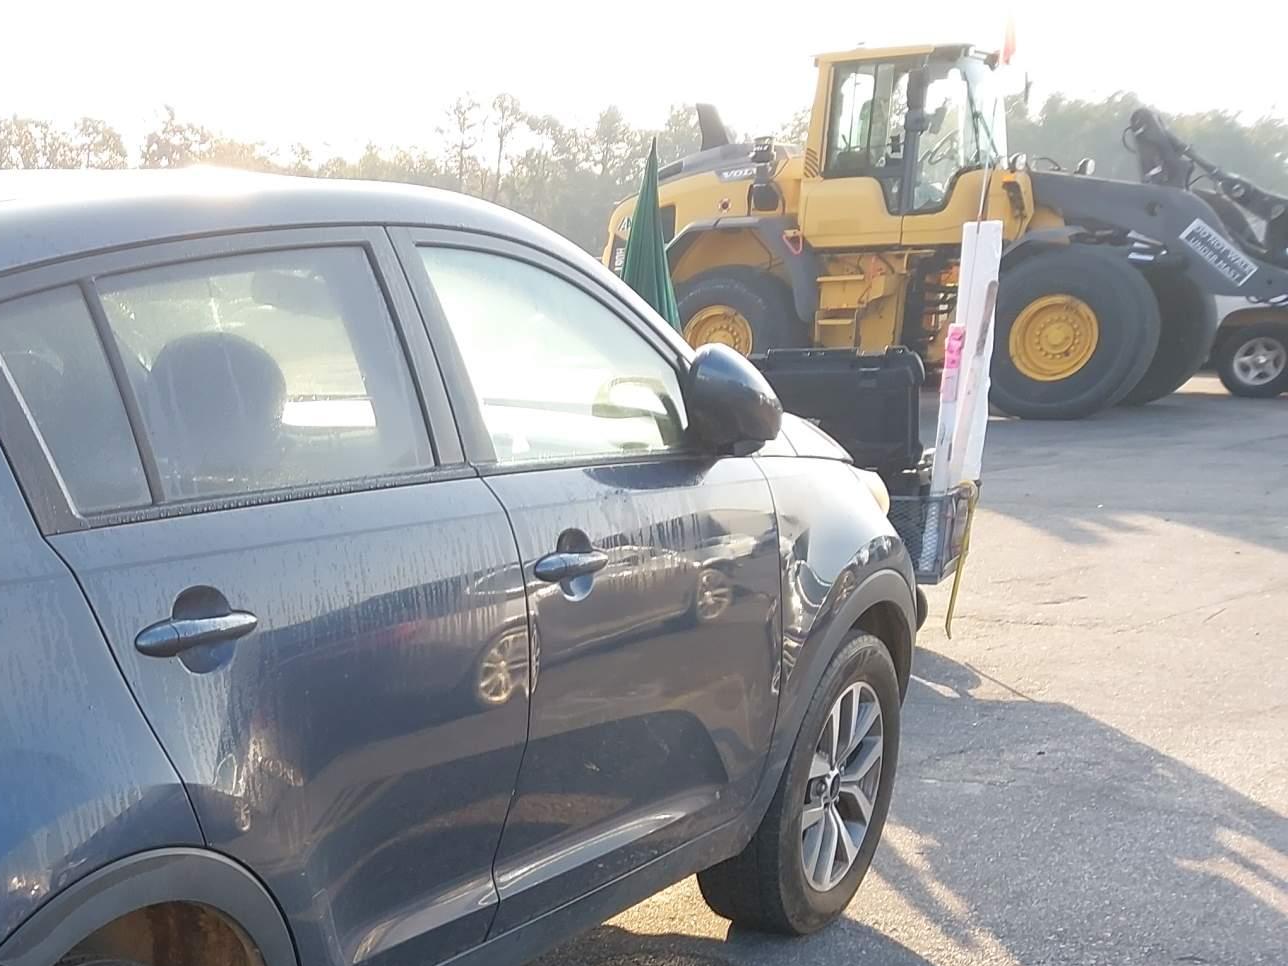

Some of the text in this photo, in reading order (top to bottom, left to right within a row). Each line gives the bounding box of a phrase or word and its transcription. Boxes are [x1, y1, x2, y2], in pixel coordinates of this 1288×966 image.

[1187, 236, 1241, 281] UNDER MAST
[1206, 234, 1228, 254] NOT
